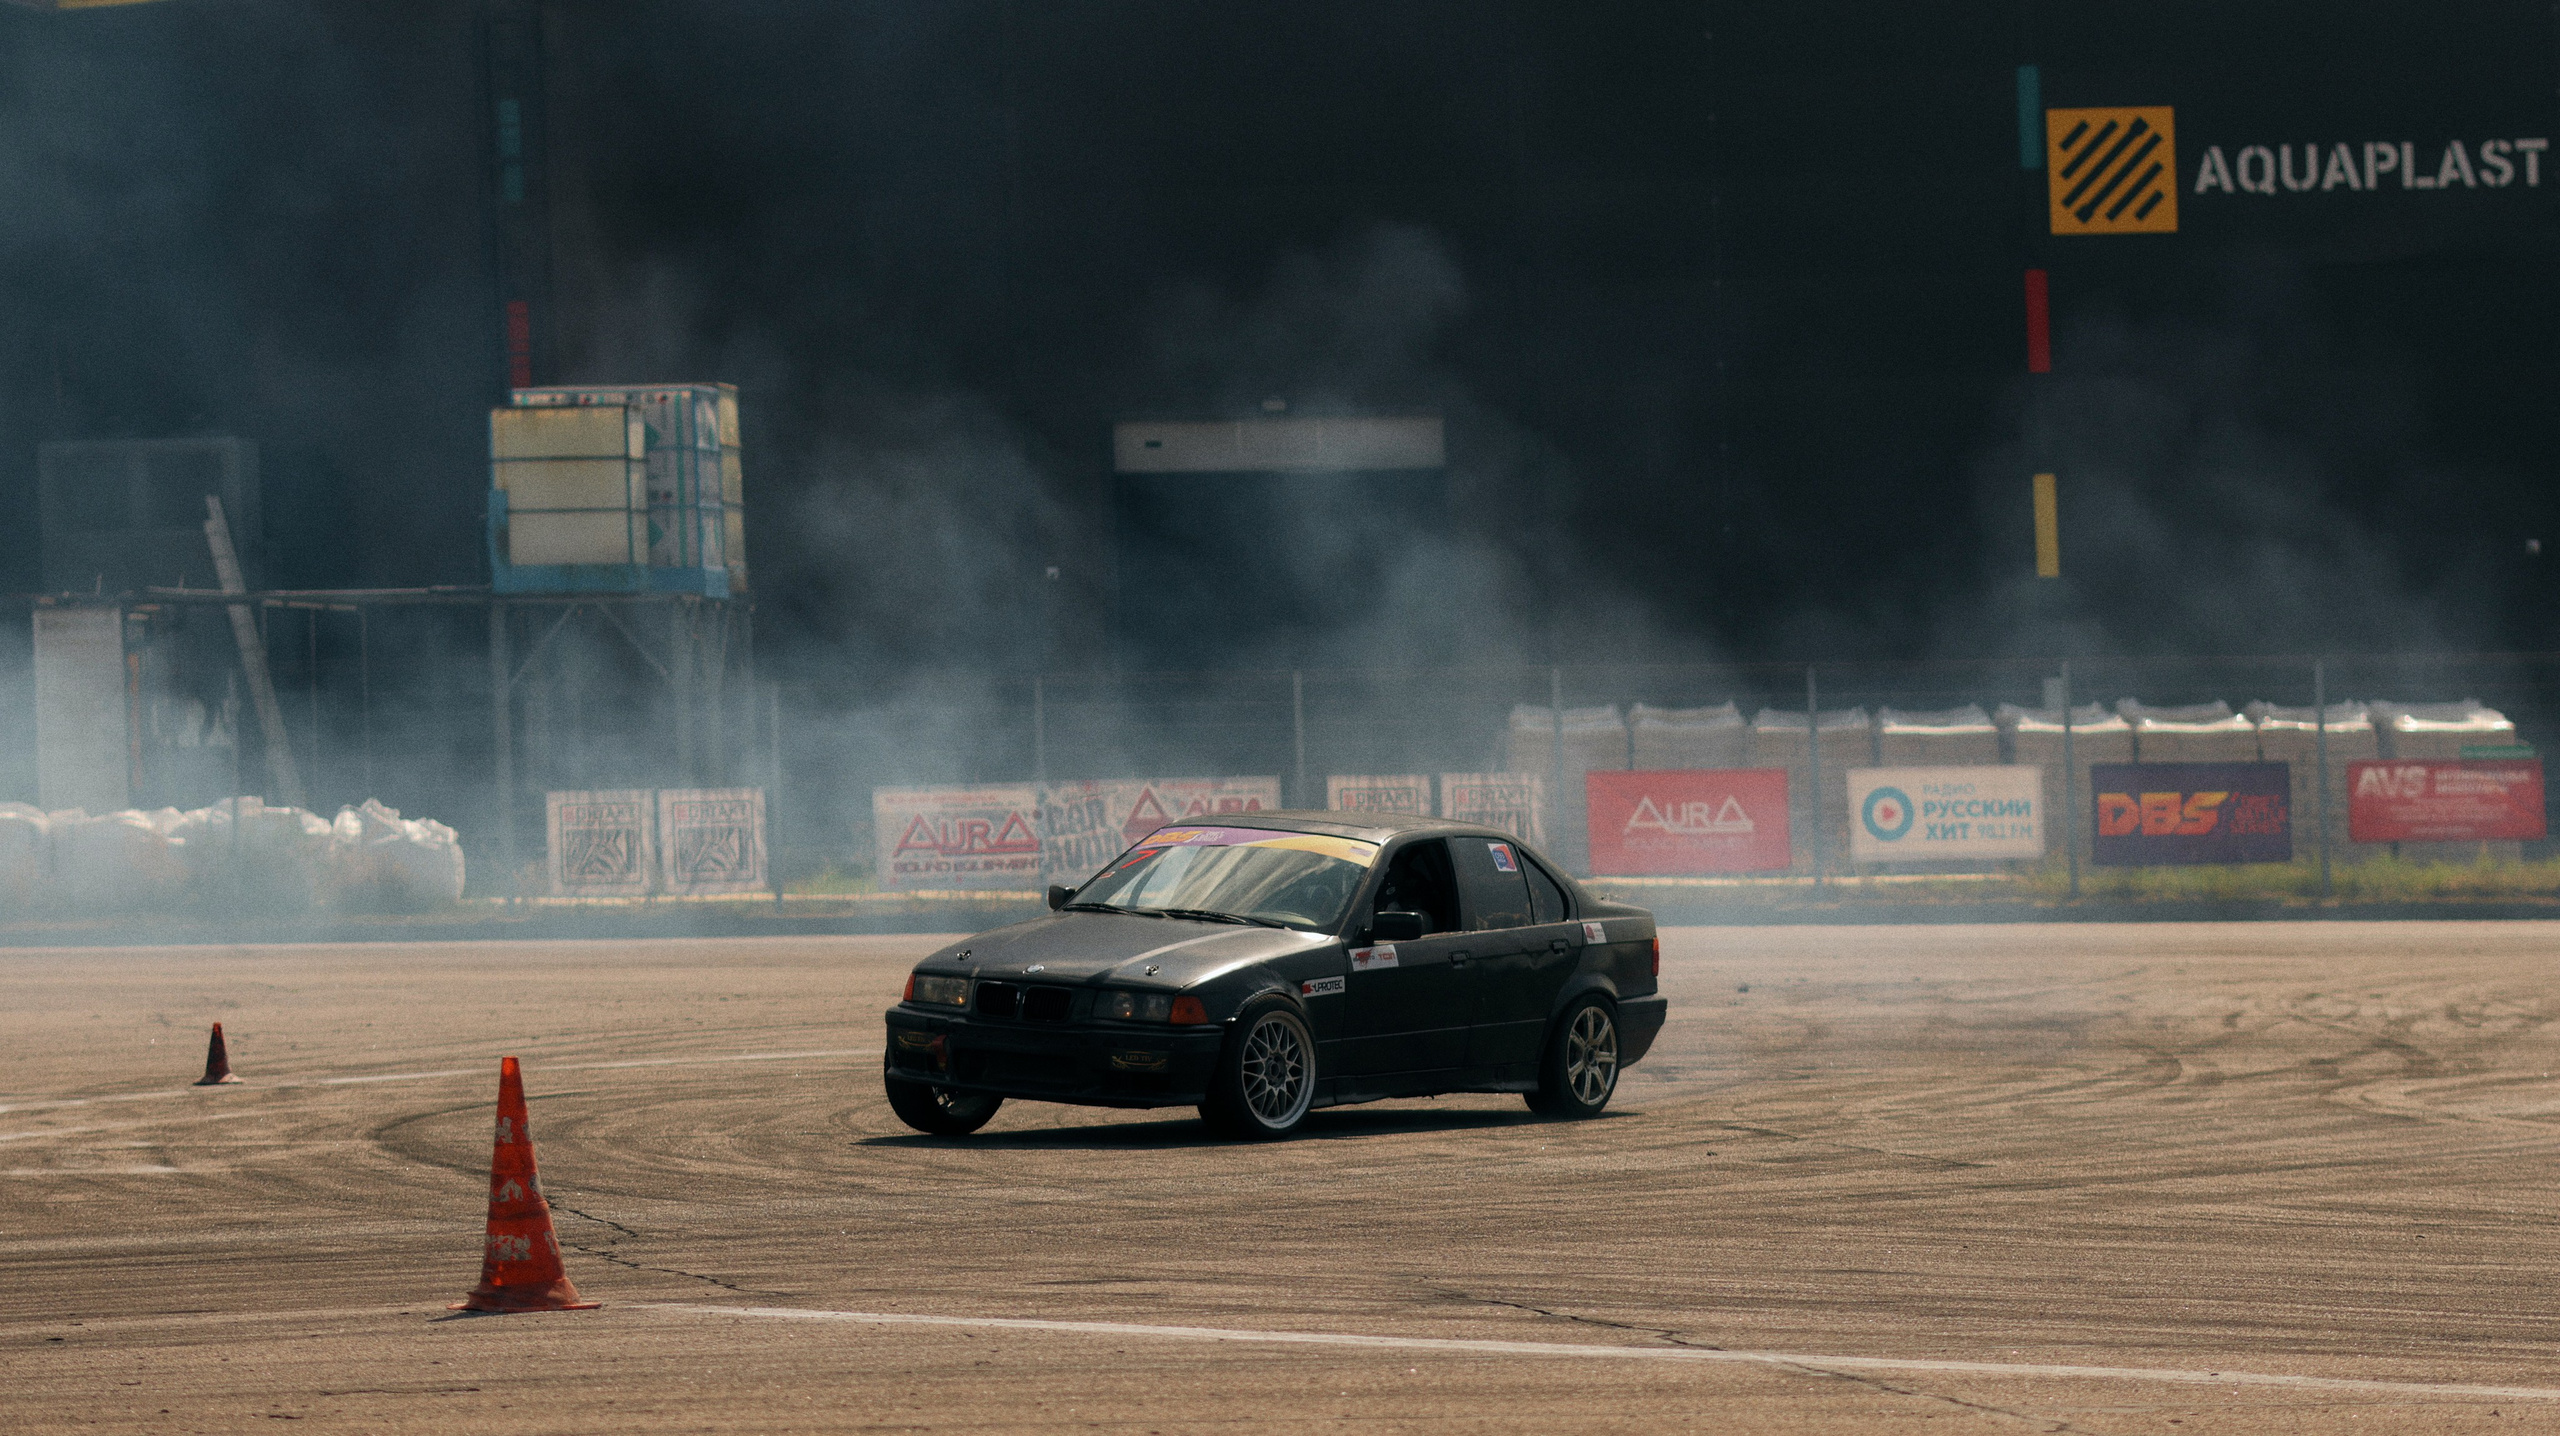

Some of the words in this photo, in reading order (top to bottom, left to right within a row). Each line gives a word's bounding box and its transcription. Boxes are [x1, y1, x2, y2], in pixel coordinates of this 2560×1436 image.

[2194, 138, 2549, 194] AQUAPLAST
[1922, 783, 1976, 797] РАДИО
[2354, 765, 2428, 798] AVS
[891, 810, 1041, 857] AURA
[1623, 795, 1754, 835] AURA
[1925, 822, 1971, 841] ХИТ
[2097, 791, 2229, 837] DBS
